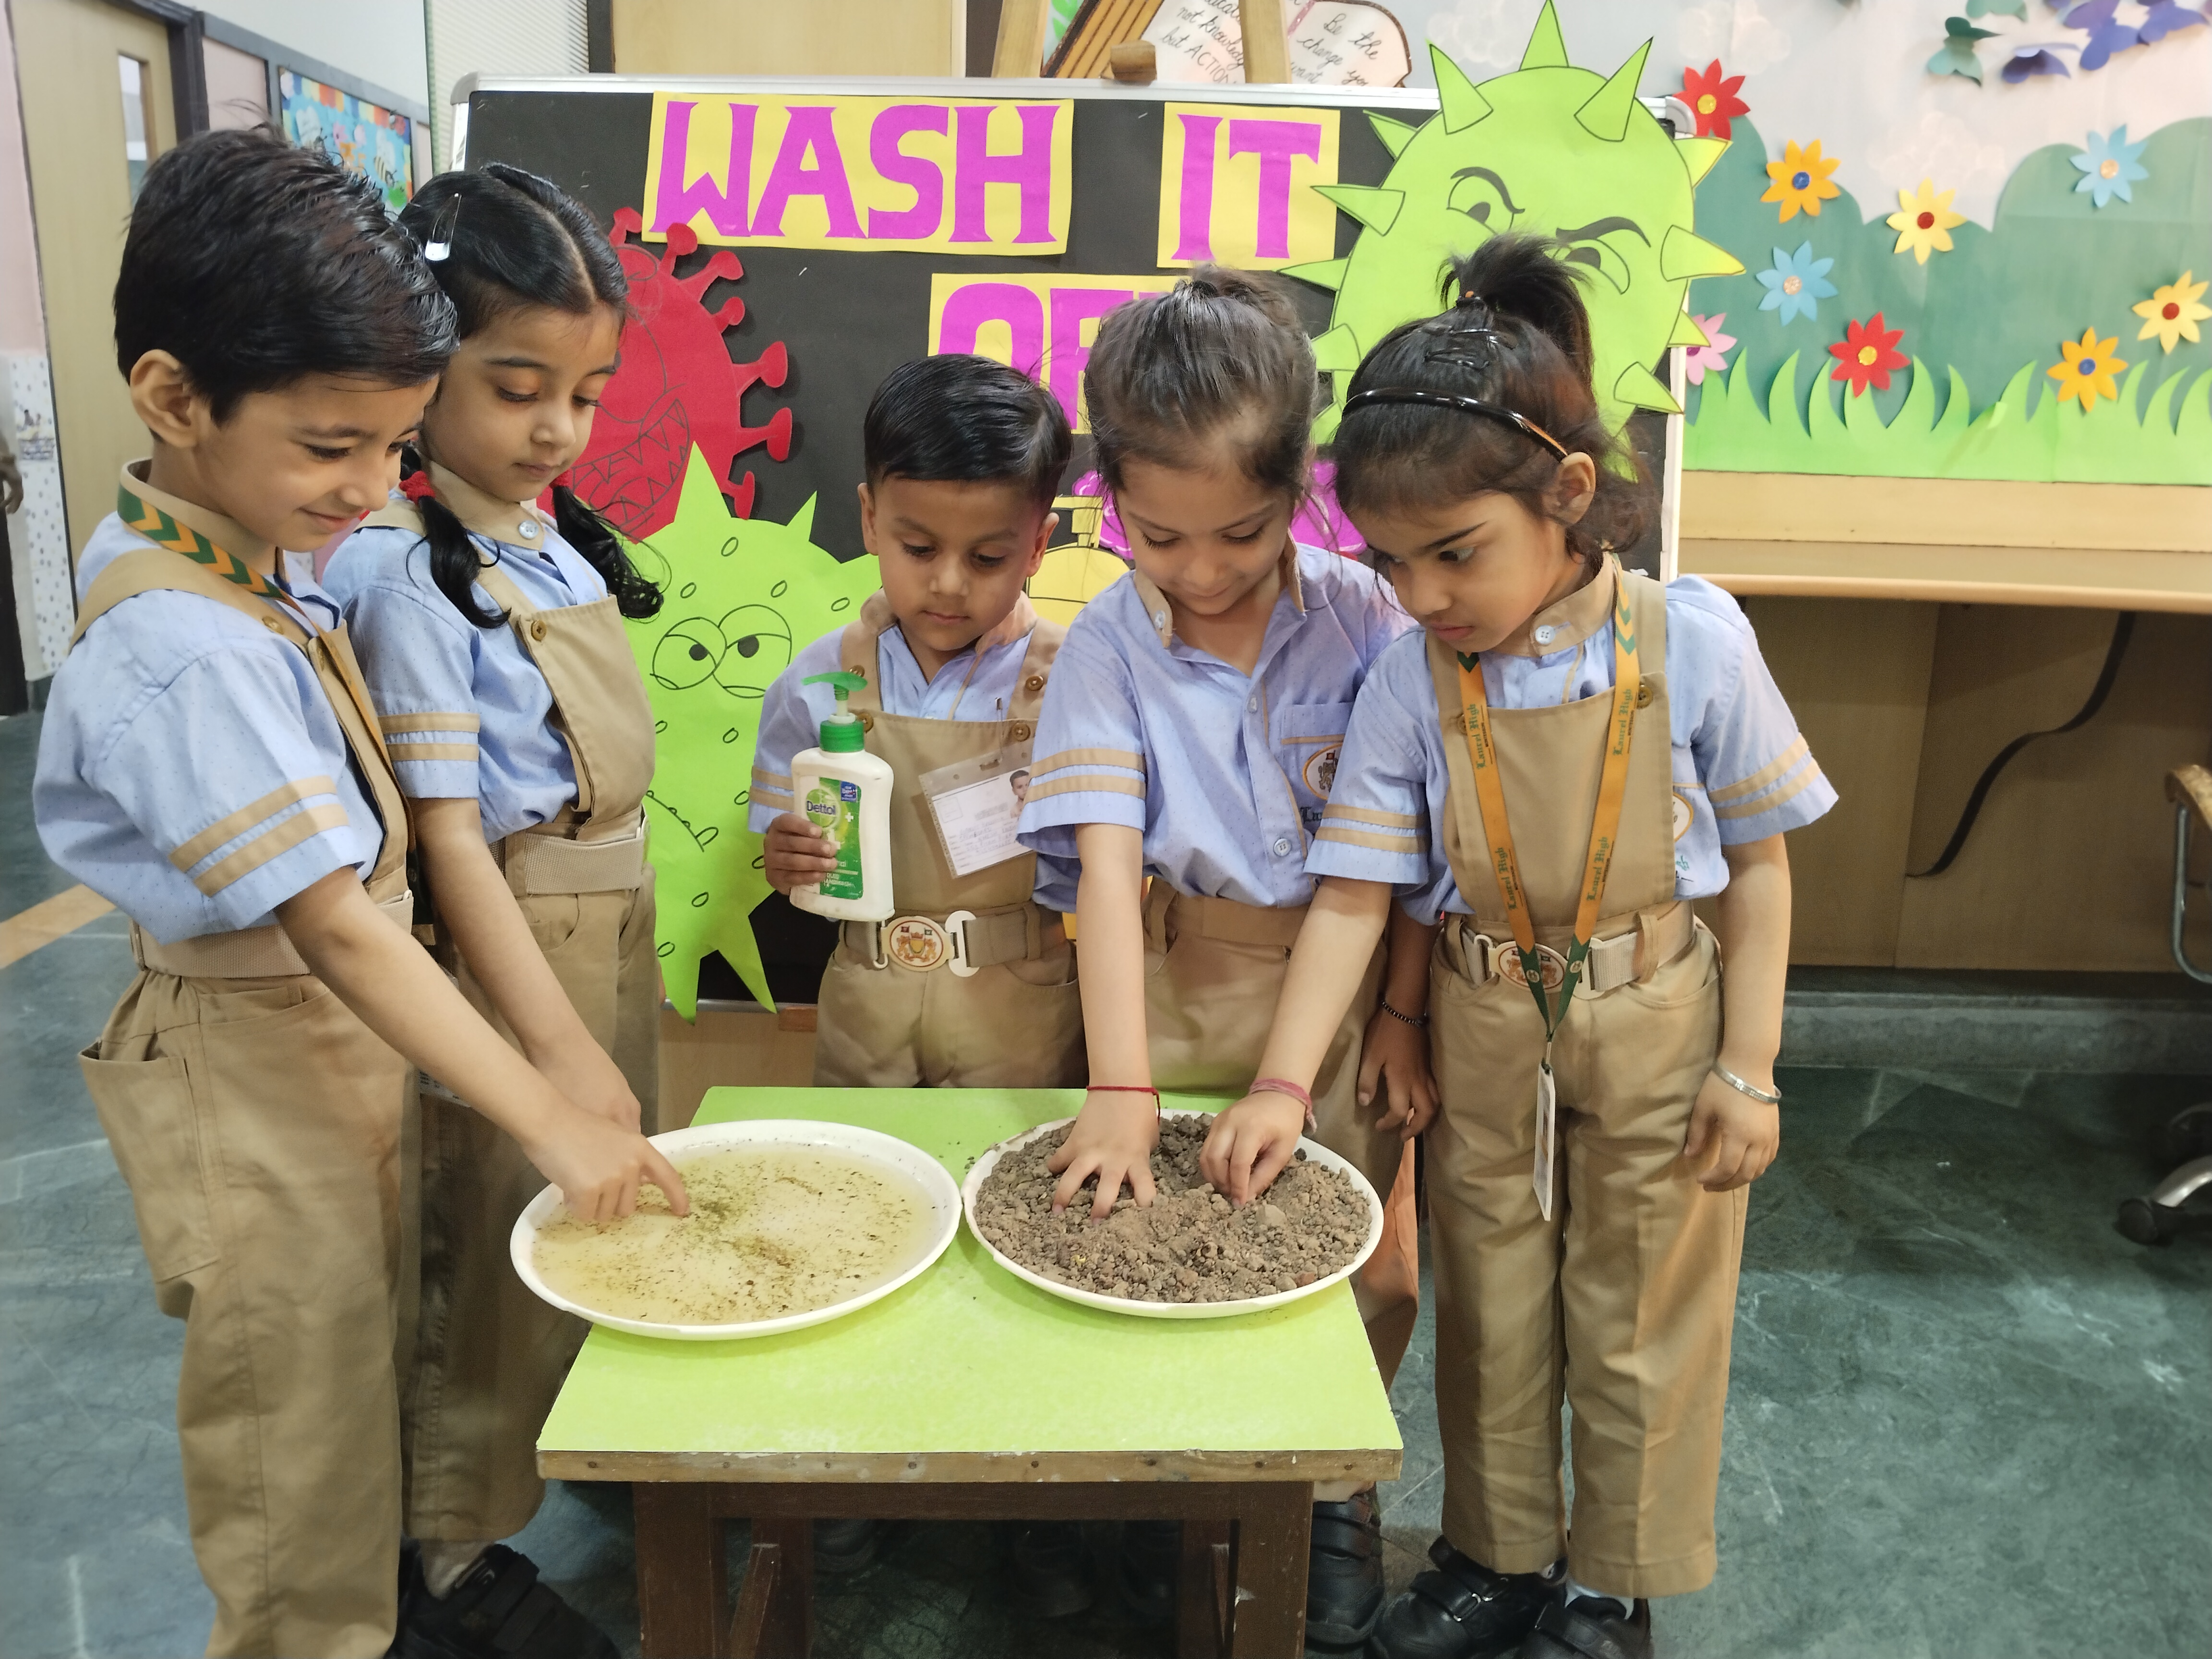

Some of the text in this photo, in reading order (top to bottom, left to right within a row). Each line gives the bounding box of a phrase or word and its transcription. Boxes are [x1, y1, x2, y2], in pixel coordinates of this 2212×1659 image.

[1159, 26, 1190, 48] but
[1177, 7, 1205, 23] not
[1324, 13, 1382, 60] Be the
[1297, 39, 1369, 86] change yo
[649, 101, 1322, 261] WASH IT
[938, 282, 1167, 430] OF
[1467, 704, 1486, 769] Laurel High
[1613, 689, 1633, 755] Laurel High
[807, 801, 836, 815] Dettol
[1495, 848, 1517, 910] Laurel High
[1587, 837, 1609, 900] Laurel High
